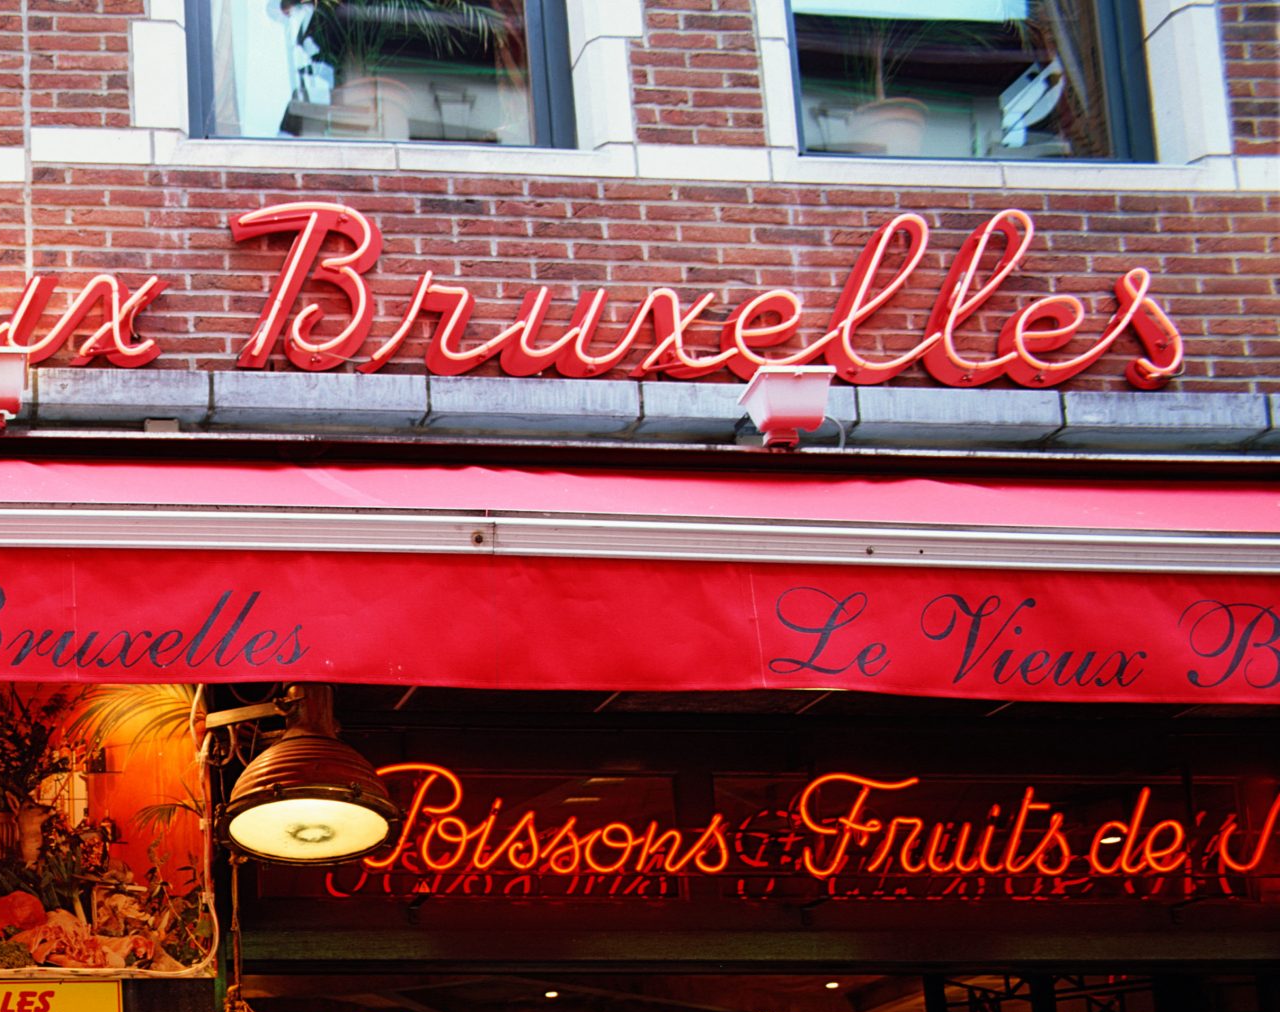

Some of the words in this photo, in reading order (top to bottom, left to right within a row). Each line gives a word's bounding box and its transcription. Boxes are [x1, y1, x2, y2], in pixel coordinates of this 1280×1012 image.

[231, 199, 1186, 389] Bruxelles
[768, 586, 891, 677] Le
[921, 593, 1148, 688] Vieux
[363, 762, 730, 875] Poissons
[800, 773, 1071, 876] Fruits
[1090, 787, 1187, 875] de
